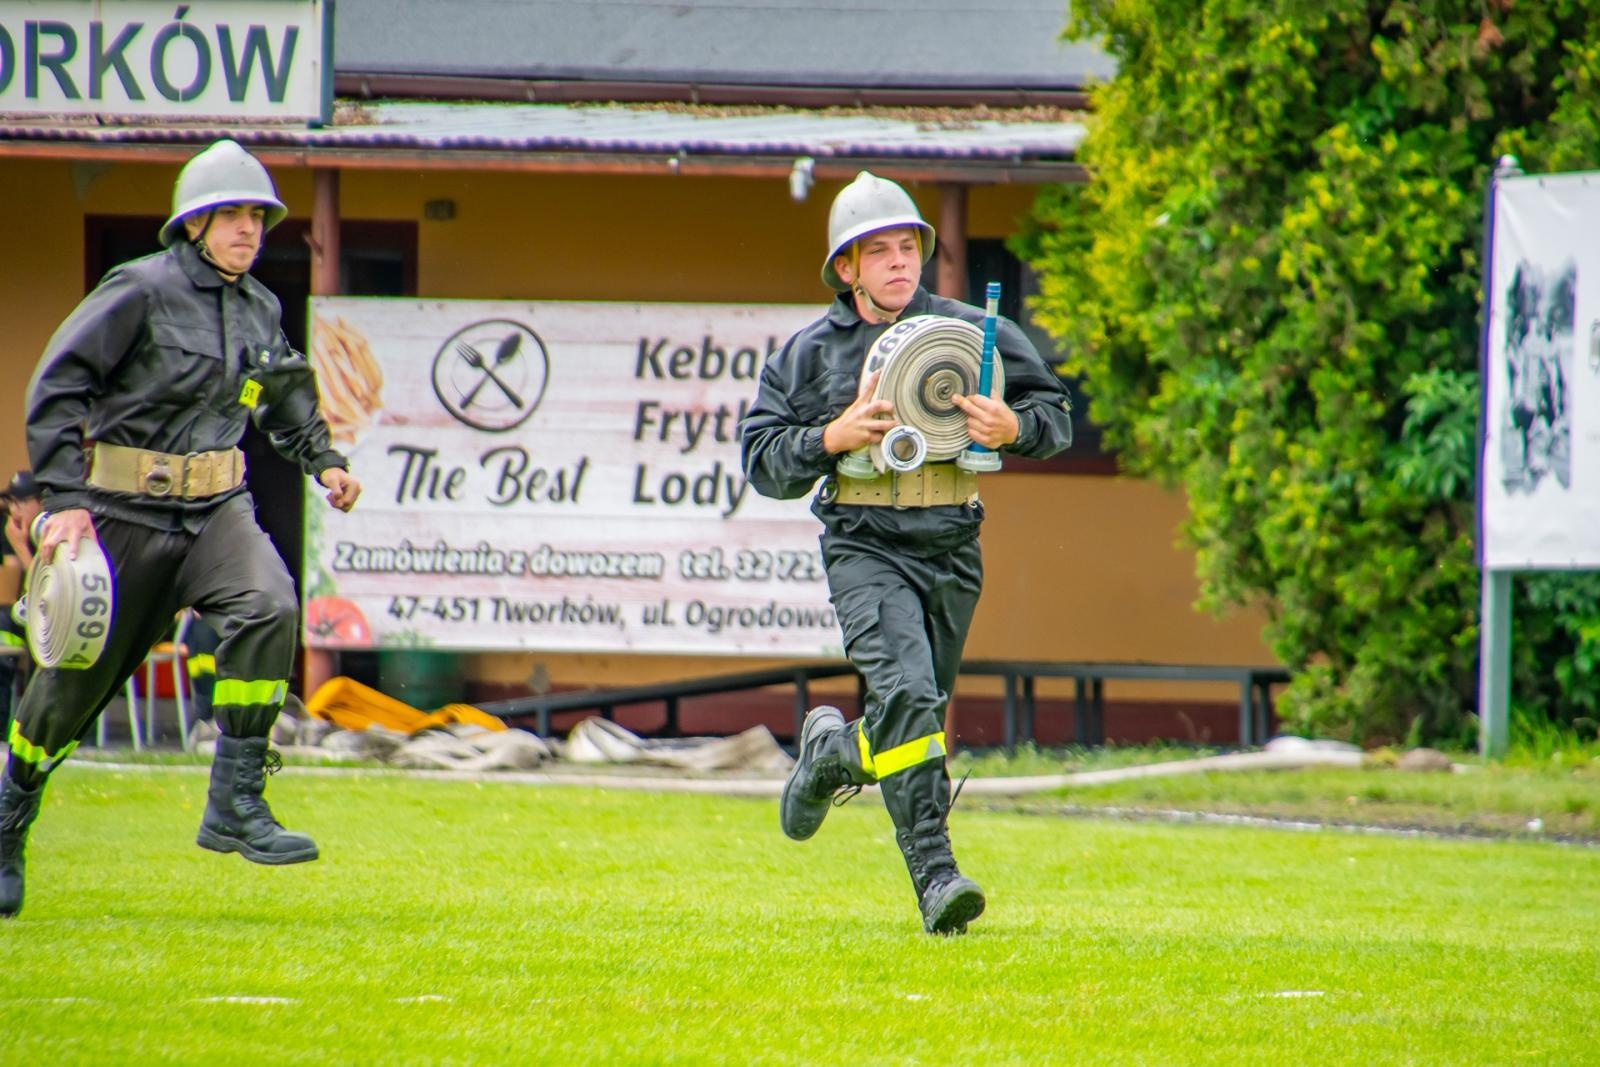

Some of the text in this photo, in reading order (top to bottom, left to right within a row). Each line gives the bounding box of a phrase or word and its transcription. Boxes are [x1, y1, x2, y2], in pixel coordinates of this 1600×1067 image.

[0, 5, 300, 103] RKÓW
[387, 444, 590, 507] The Best
[633, 461, 748, 519] Lody
[332, 539, 506, 575] Zamówienia
[508, 551, 527, 576] z
[530, 543, 664, 579] dowozem
[680, 545, 732, 580] tel.
[735, 549, 773, 581] 32
[388, 594, 835, 634] 47-451 Tworków, ul. Ogrodowa
